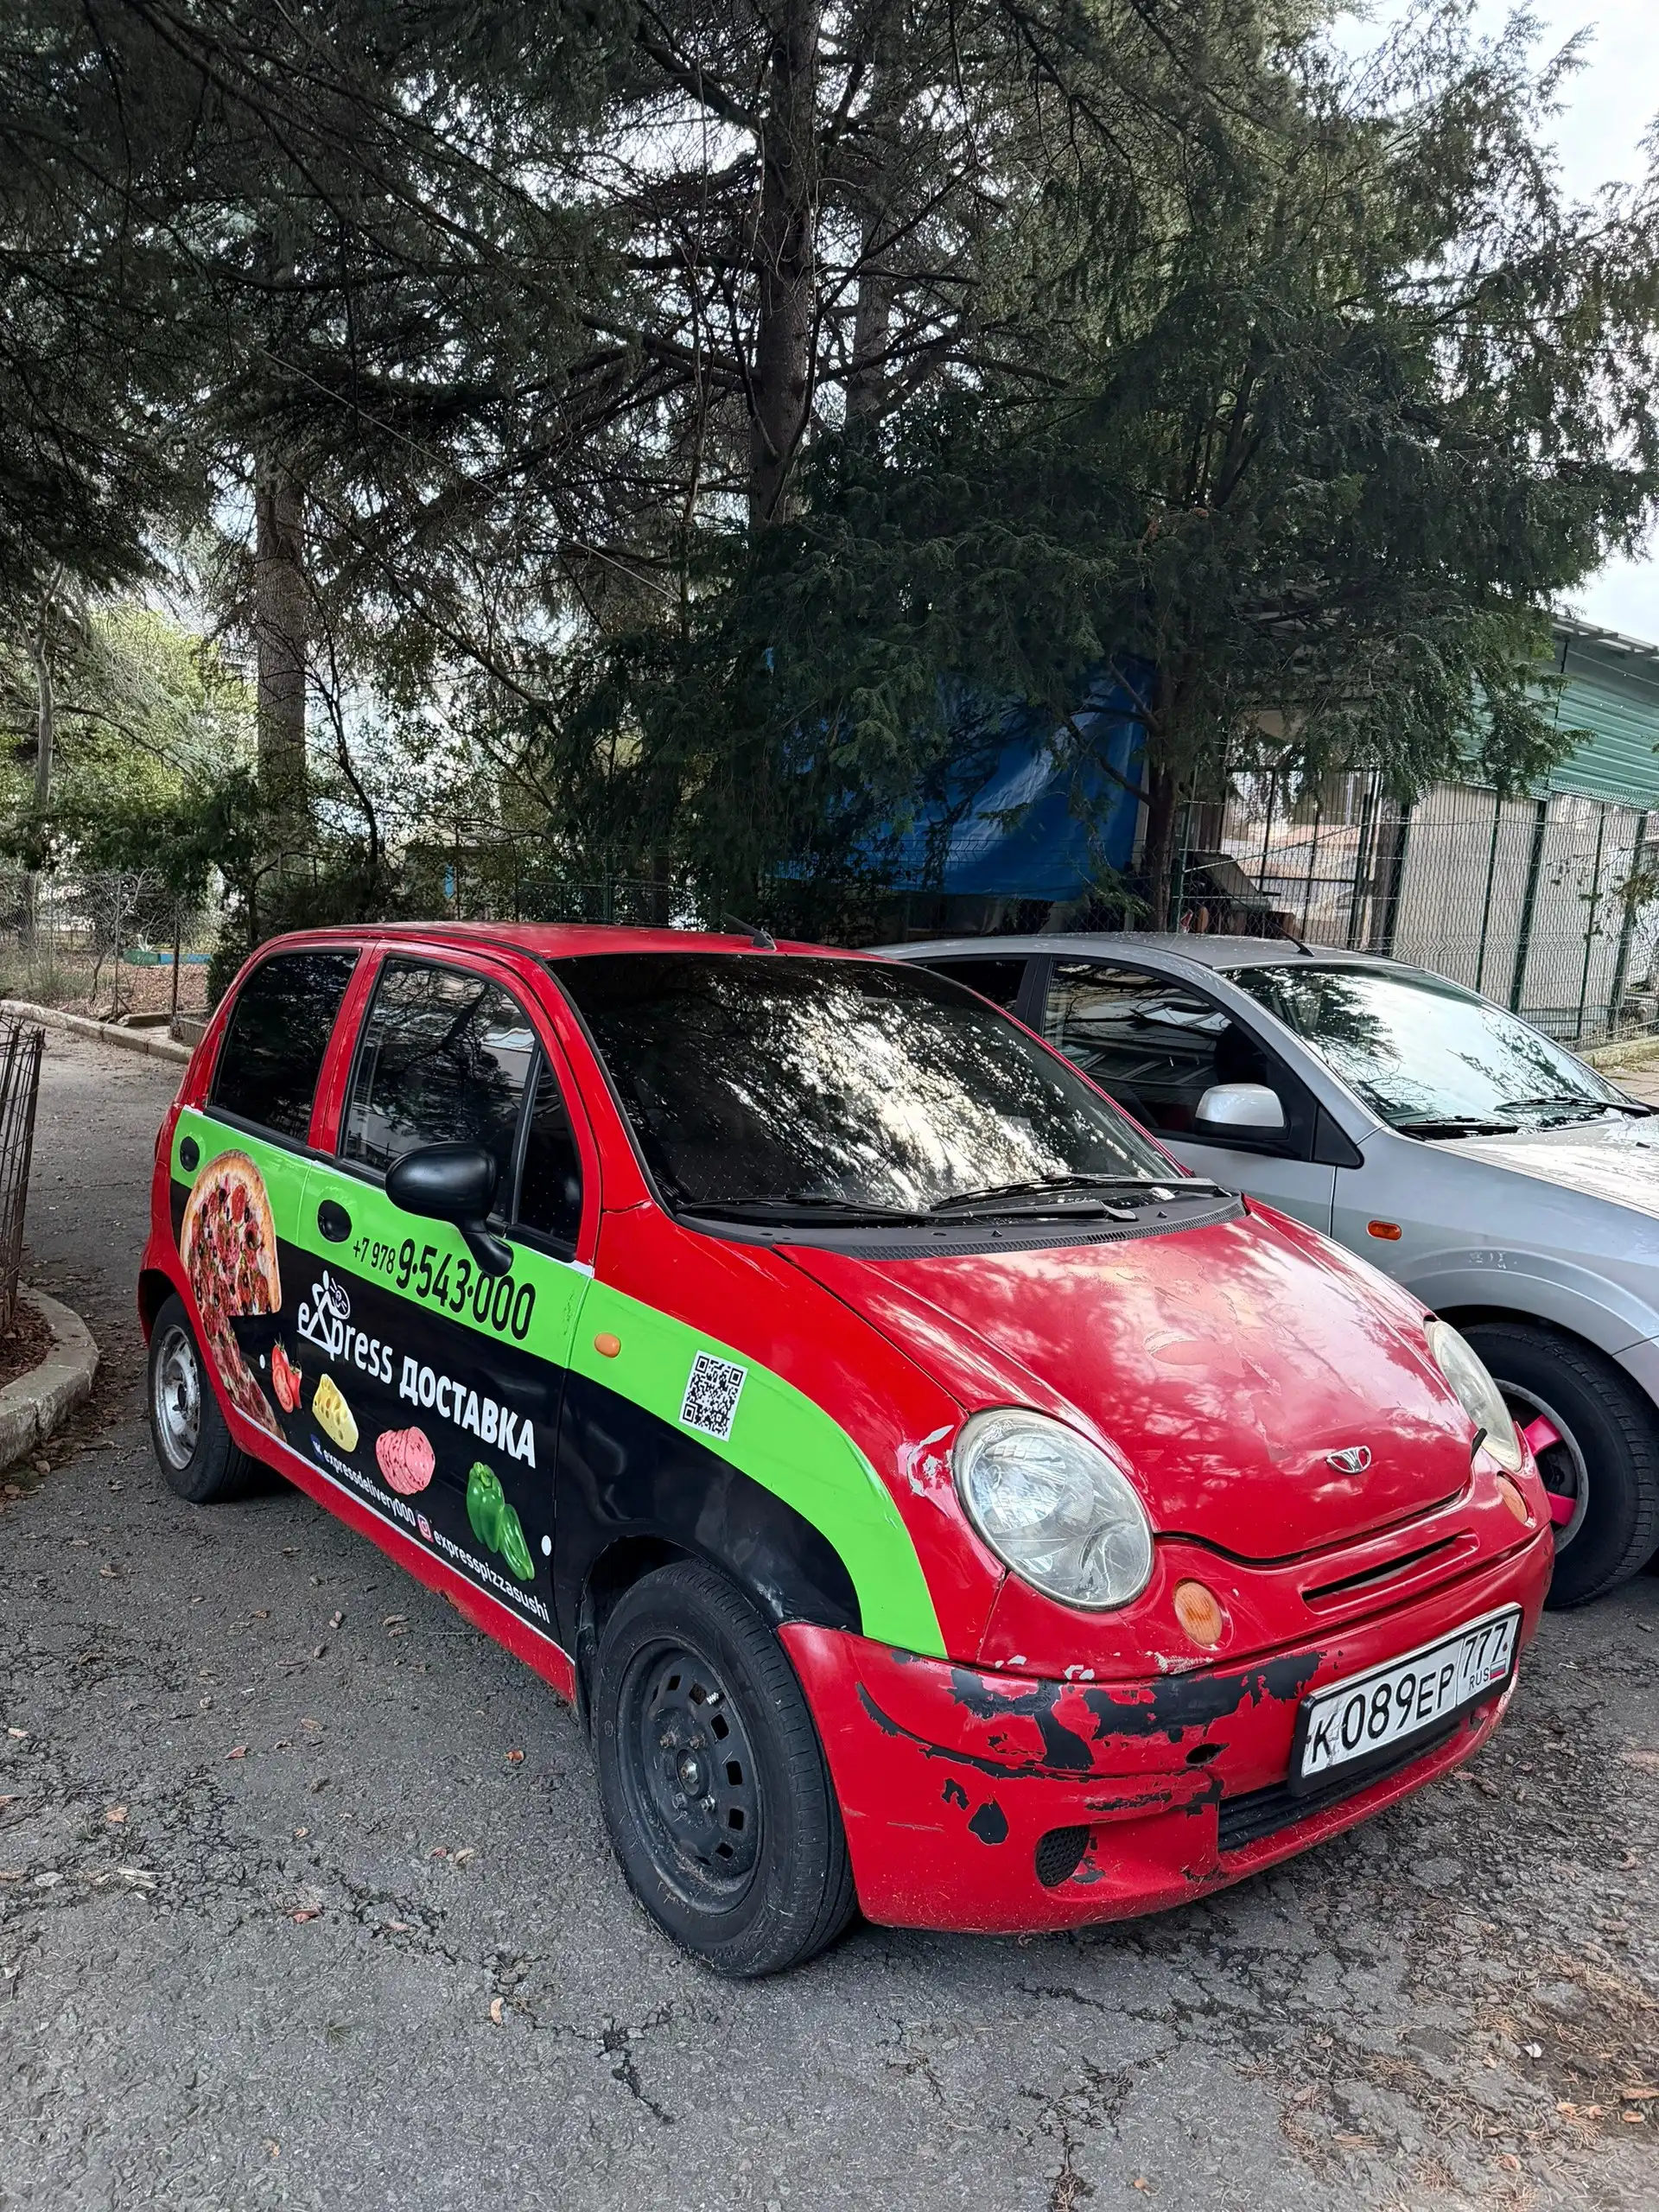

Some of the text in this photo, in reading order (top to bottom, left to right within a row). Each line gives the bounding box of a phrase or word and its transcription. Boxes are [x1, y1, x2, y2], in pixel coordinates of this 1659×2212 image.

[353, 1237, 369, 1262] +7
[372, 1242, 396, 1274] 978
[399, 1356, 537, 1468] ДОСТАВКА
[323, 1450, 416, 1527] expressdelivery000
[434, 1531, 550, 1624] expresspizzasushi
[1463, 1623, 1508, 1679] 777
[1469, 1668, 1490, 1691] RUS
